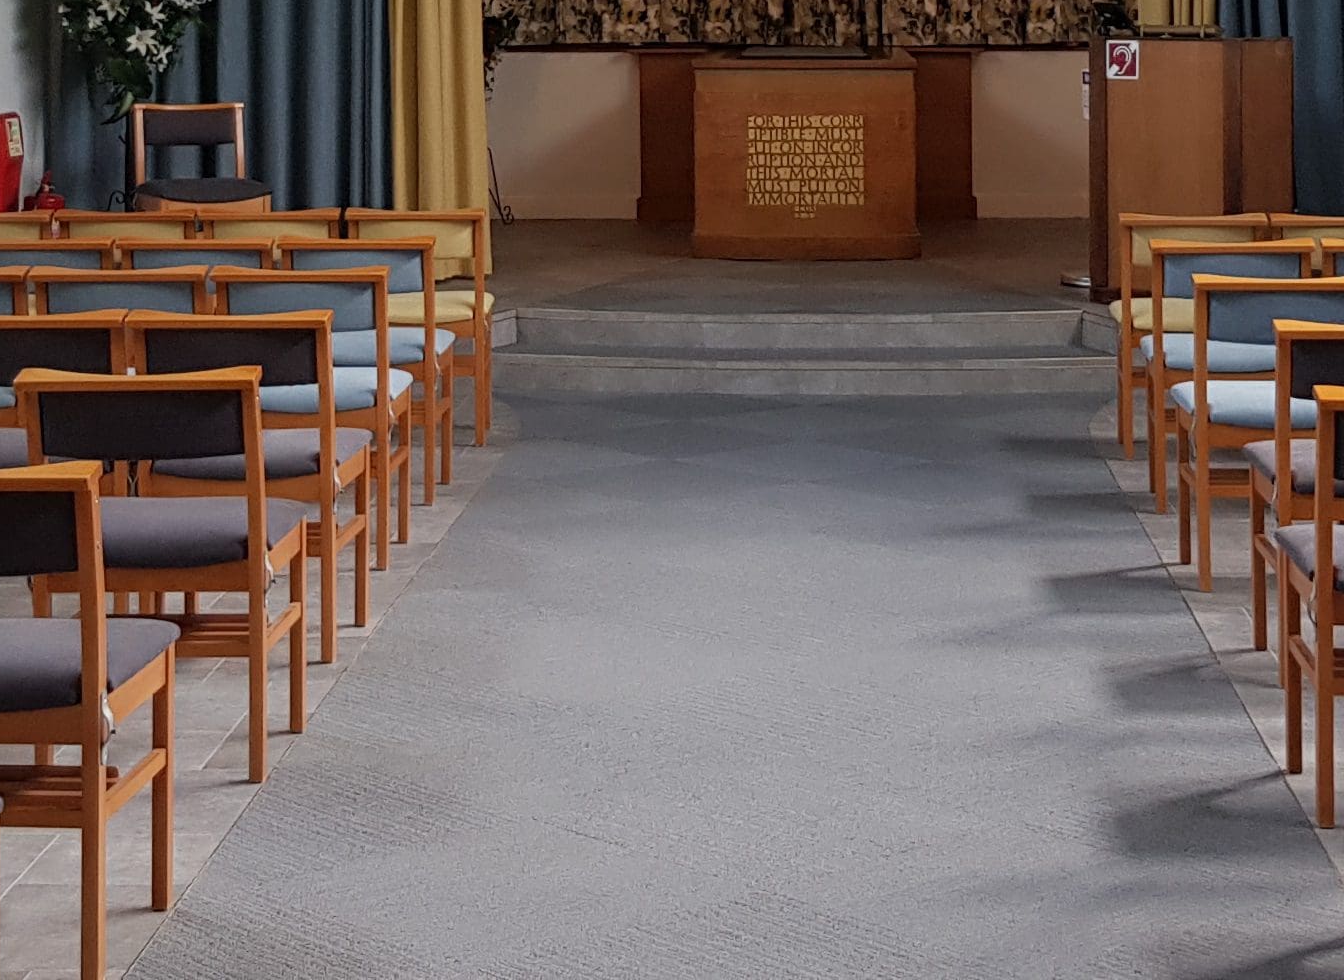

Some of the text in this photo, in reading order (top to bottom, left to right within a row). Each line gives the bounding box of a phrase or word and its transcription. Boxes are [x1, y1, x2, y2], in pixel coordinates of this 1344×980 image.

[780, 140, 804, 154] ON
[823, 153, 861, 167] AND
[835, 179, 860, 193] ON
